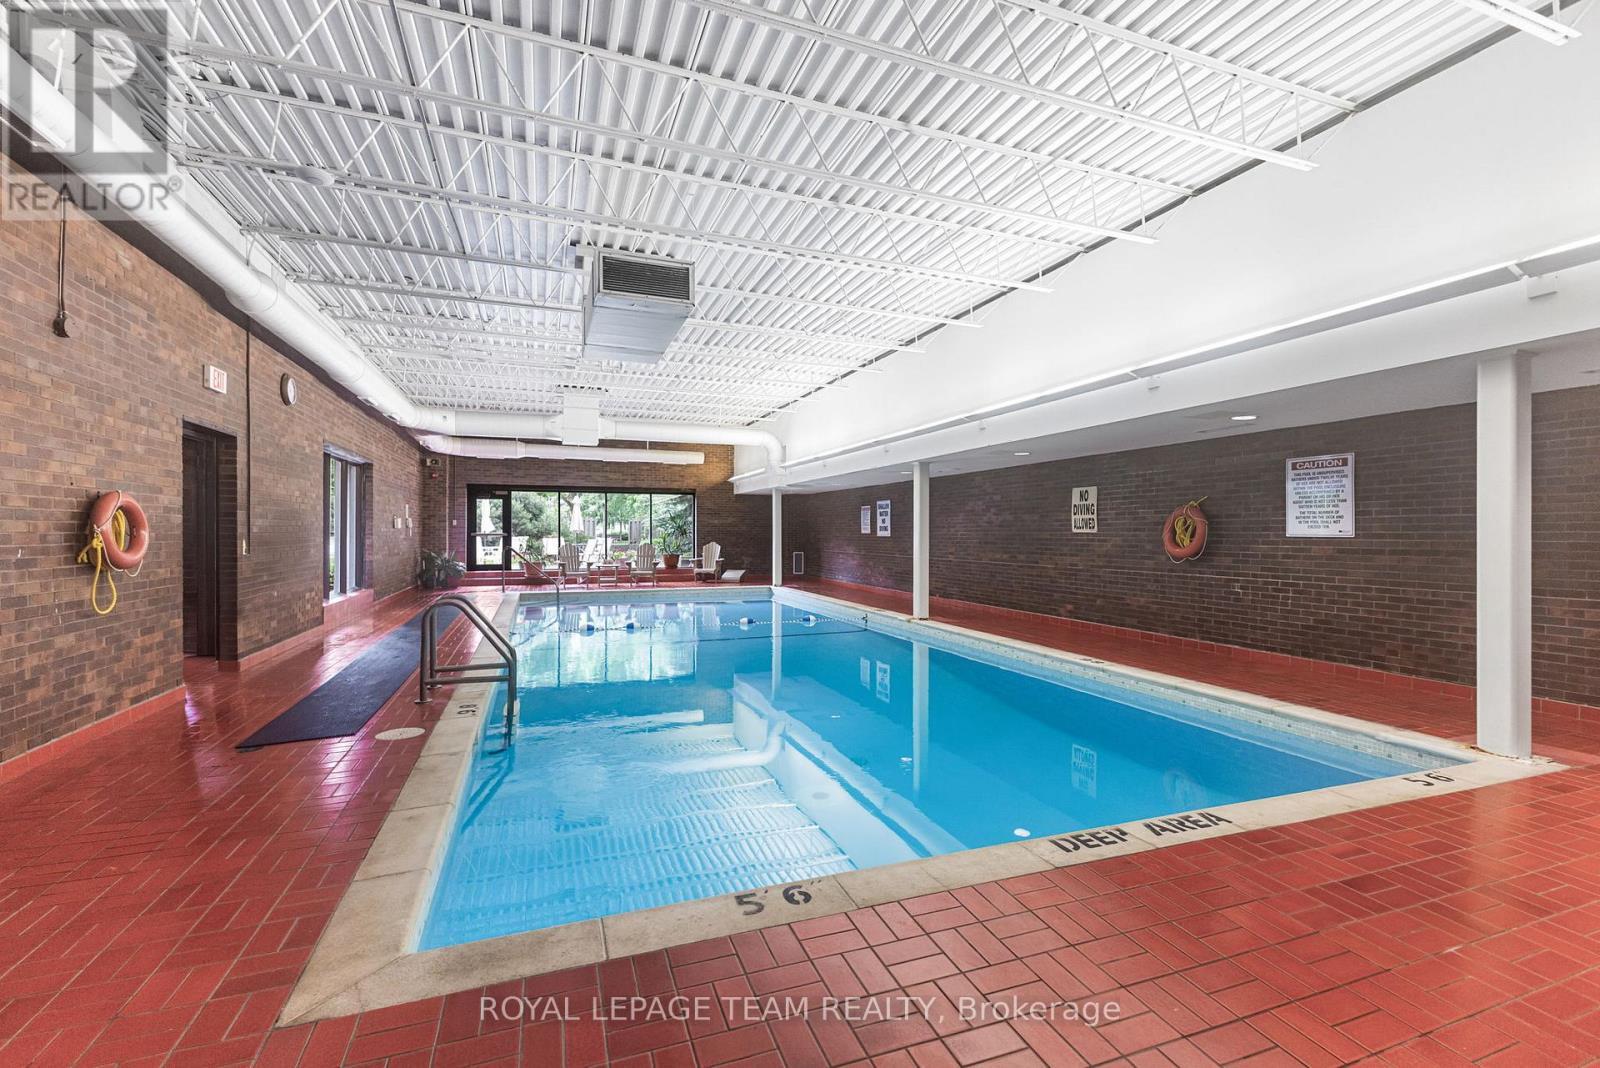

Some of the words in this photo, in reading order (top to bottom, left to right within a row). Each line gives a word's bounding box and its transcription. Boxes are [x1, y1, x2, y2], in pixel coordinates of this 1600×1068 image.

[1296, 459, 1342, 469] CAUTION
[1080, 490, 1089, 502] NO
[1073, 504, 1095, 515] DIVING
[1073, 517, 1096, 530] ALLOWED
[1048, 827, 1128, 853] DEEP
[1143, 811, 1233, 837] AREA
